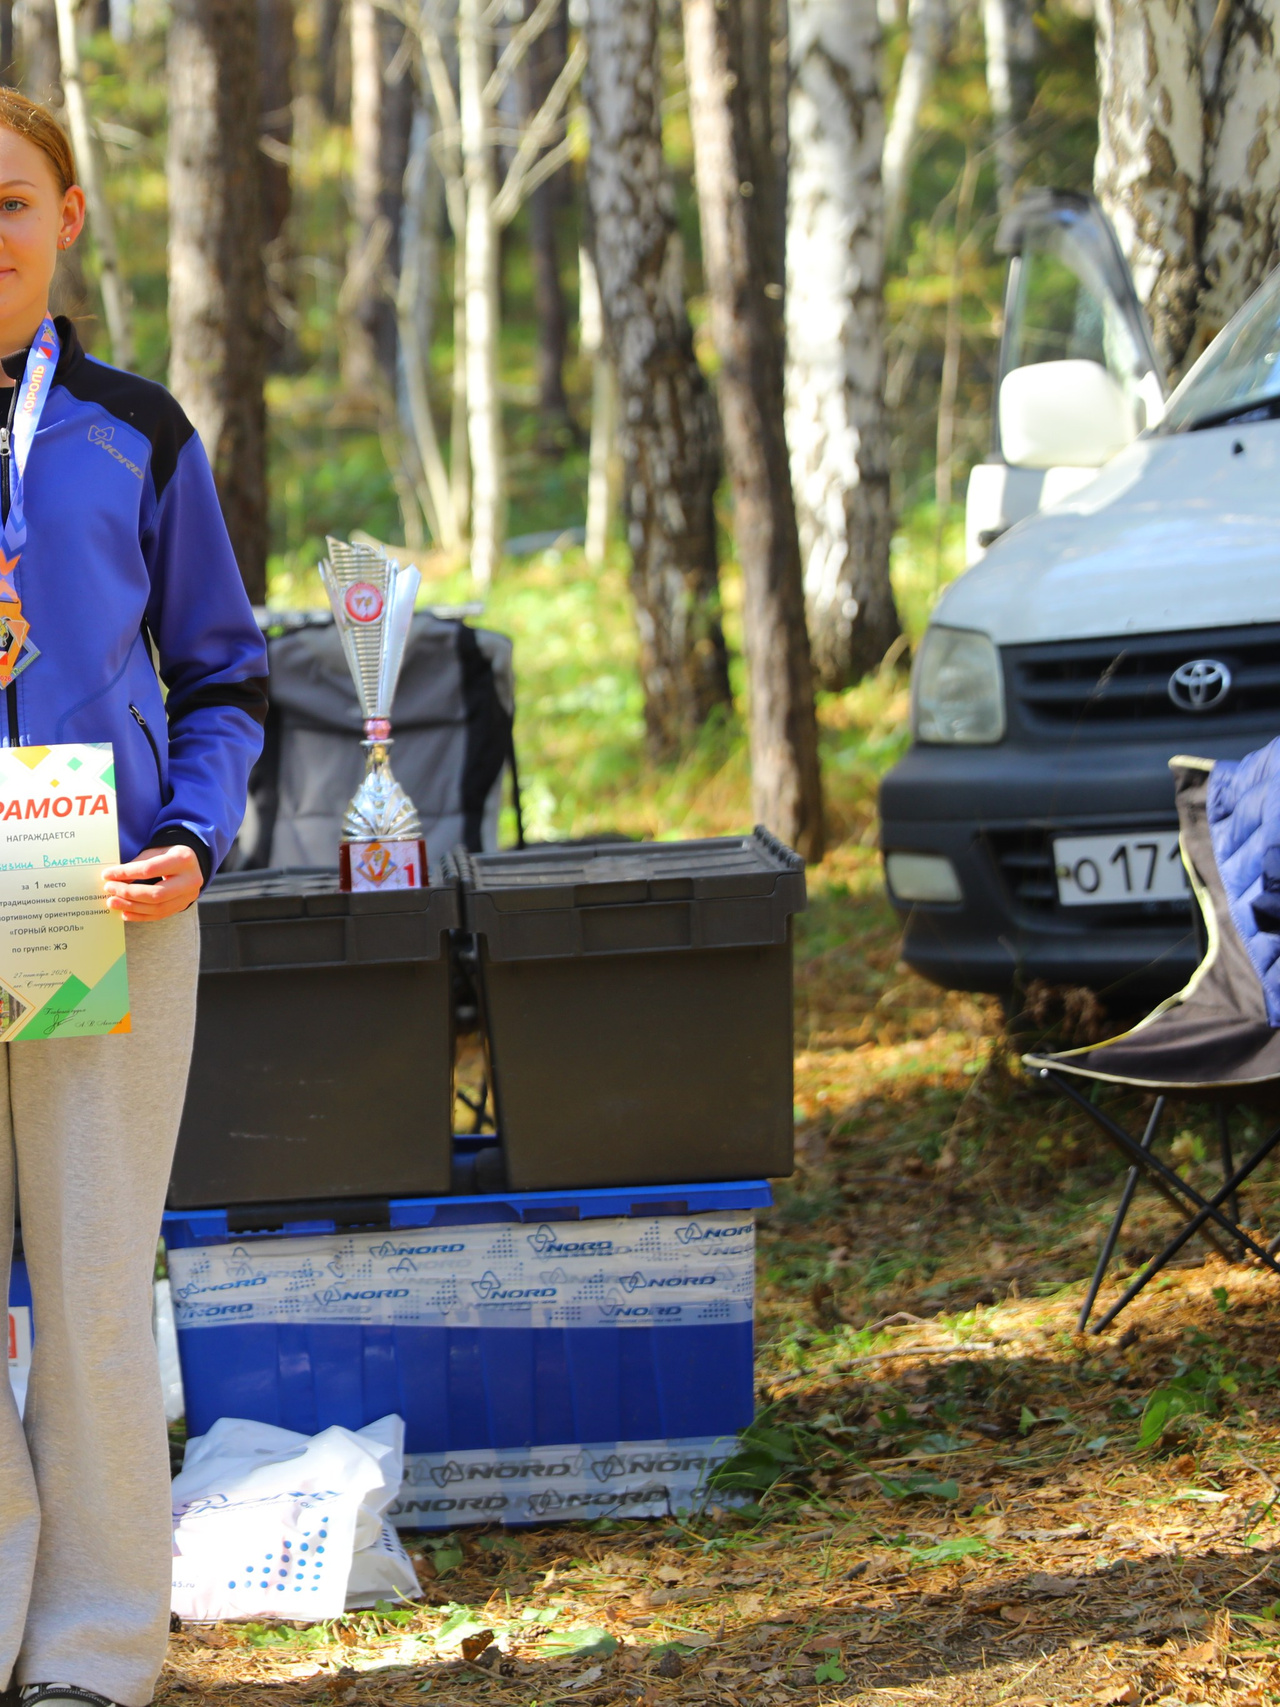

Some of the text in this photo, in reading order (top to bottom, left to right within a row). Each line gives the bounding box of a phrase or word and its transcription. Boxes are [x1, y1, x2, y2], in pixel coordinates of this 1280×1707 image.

[95, 440, 144, 479] NORD
[6, 831, 75, 842] НАГРАЖДАЕТСЯ
[403, 863, 415, 886] 1
[0, 898, 56, 908] традиционных
[45, 909, 110, 919] ориентированию
[23, 944, 51, 954] группе:
[54, 943, 67, 951] ЖЭ
[395, 1244, 465, 1255] NORD
[547, 1241, 613, 1253] NORD
[200, 1276, 267, 1292] NORD
[648, 1275, 716, 1287] NORD
[340, 1288, 409, 1301] NORD
[490, 1287, 557, 1299] NORD
[189, 1303, 253, 1318] NORD
[615, 1305, 681, 1316] NORD
[467, 1463, 571, 1479] NORD
[566, 1489, 667, 1506] NORD
[404, 1495, 508, 1513] NORD
